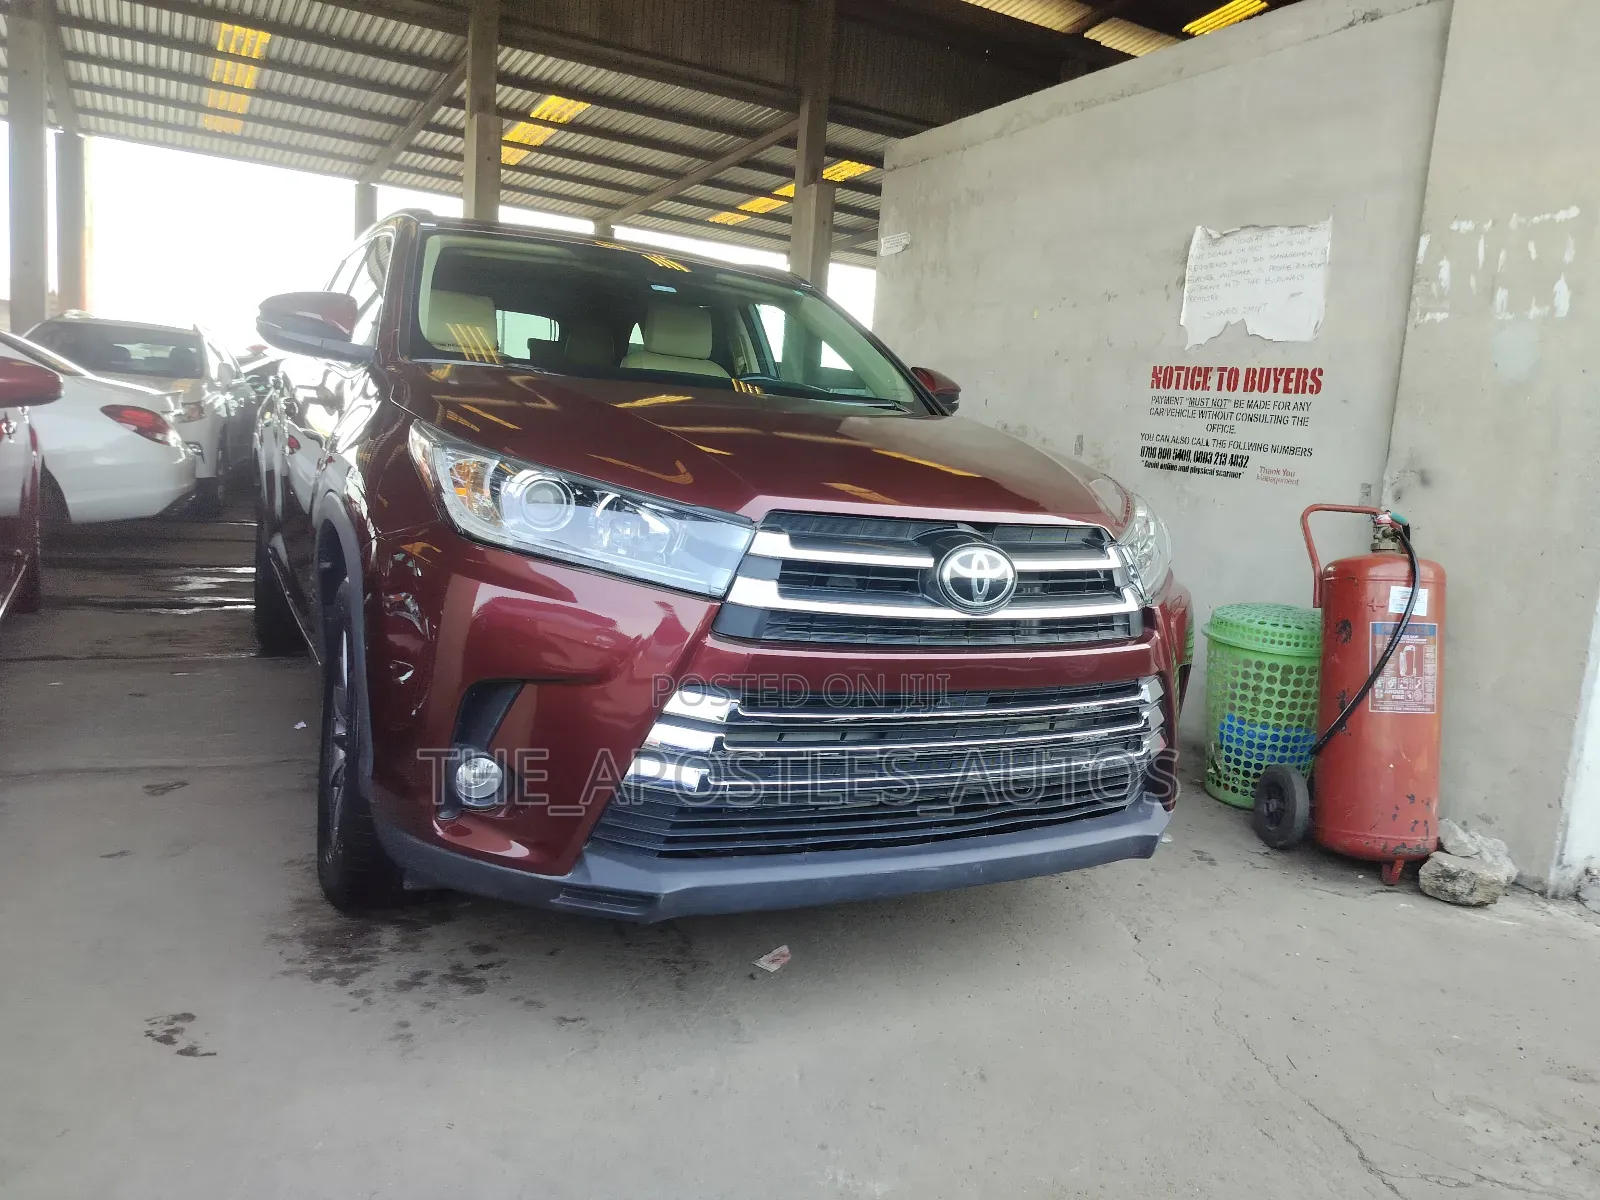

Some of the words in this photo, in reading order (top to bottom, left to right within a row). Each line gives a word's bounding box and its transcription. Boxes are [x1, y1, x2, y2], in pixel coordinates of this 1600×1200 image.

[1150, 365, 1213, 392] NOTICE
[1216, 366, 1240, 393] TO
[1242, 367, 1324, 395] BUYERS
[1150, 395, 1185, 406] PAYMENT
[1233, 399, 1245, 409] BE
[1246, 399, 1271, 410] MADE
[1272, 400, 1291, 411] FOR
[1291, 401, 1313, 412] ANY
[1197, 409, 1234, 421] WITHOUT
[1235, 412, 1290, 425] CONSULTING
[1291, 415, 1310, 427] THE
[1140, 432, 1155, 442] YOU
[1155, 433, 1170, 443] CAN
[1170, 435, 1190, 445] ALSO
[1191, 436, 1210, 447] CALL
[1211, 438, 1227, 449] THE
[1270, 444, 1313, 458] NUMBERS
[1213, 452, 1228, 466] 213
[1189, 465, 1215, 476] physical
[1259, 465, 1281, 476] Thank
[1281, 468, 1296, 478] You
[1255, 473, 1300, 486] Management
